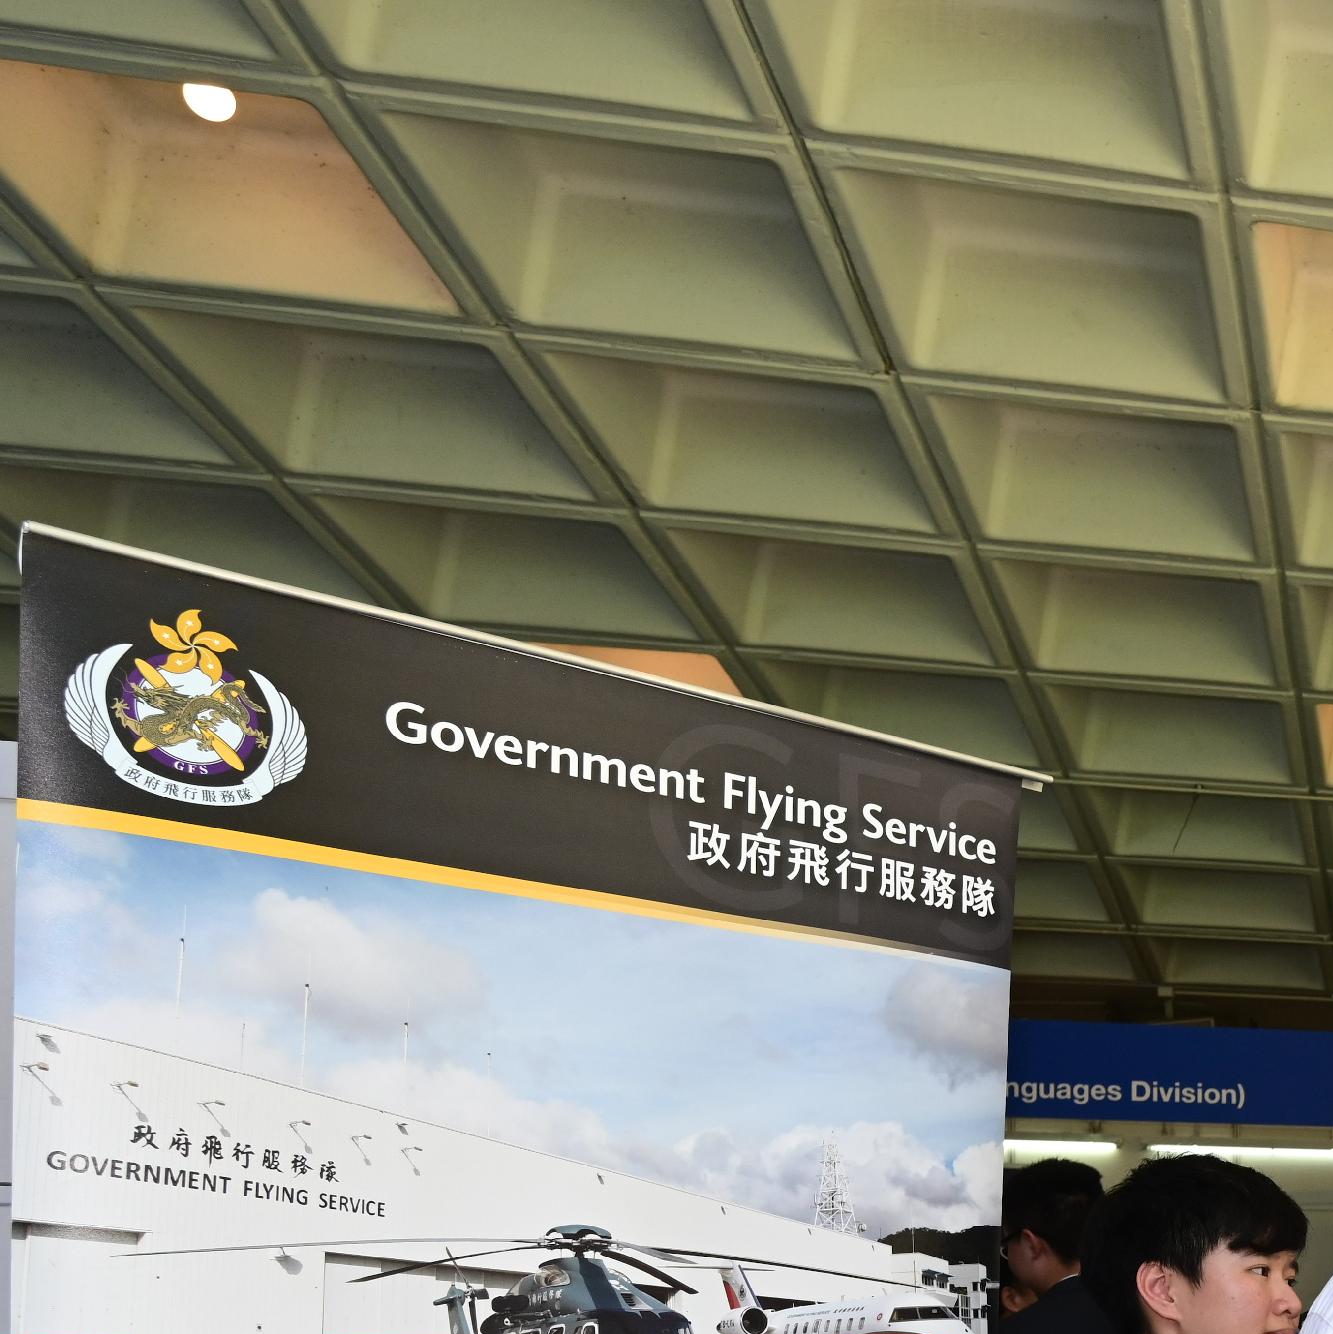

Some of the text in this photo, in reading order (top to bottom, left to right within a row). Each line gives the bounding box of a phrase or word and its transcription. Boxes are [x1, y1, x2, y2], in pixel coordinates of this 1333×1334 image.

[123, 766, 253, 803] 政府飛行服務隊
[173, 761, 209, 775] GFS
[385, 702, 997, 864] Government Flying Service
[687, 821, 996, 918] 政府飛行服務隊
[1005, 1079, 1246, 1109] nguages Division)
[46, 1149, 386, 1217] GOVERNMENT FLYING SERVICE
[129, 1125, 341, 1184] 政府飛行服務隊
